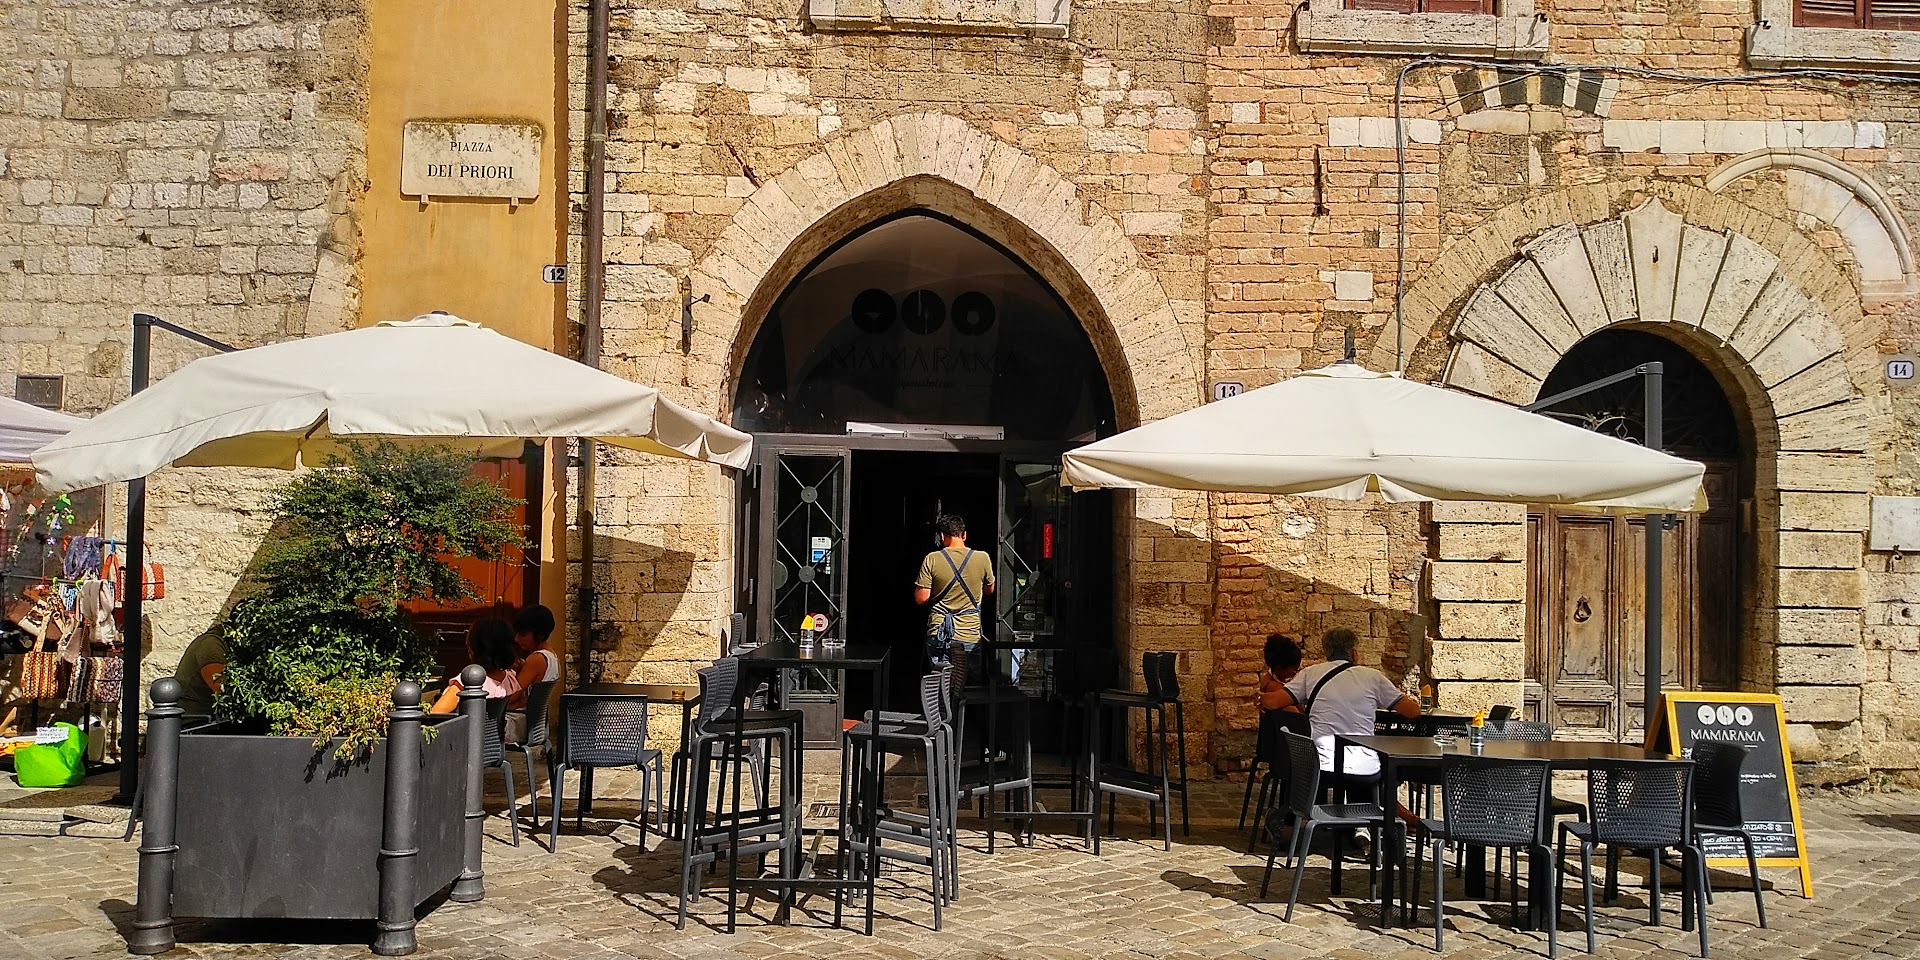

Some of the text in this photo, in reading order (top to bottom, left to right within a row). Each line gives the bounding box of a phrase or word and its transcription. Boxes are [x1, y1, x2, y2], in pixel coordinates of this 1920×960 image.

[450, 141, 493, 153] PIAZZA
[427, 164, 514, 179] DEI PRIORI
[549, 268, 565, 281] 12
[829, 344, 1019, 375] MAMARAMA
[1893, 364, 1907, 376] 14
[1221, 385, 1236, 398] 13
[1690, 728, 1765, 742] MAMARAMA
